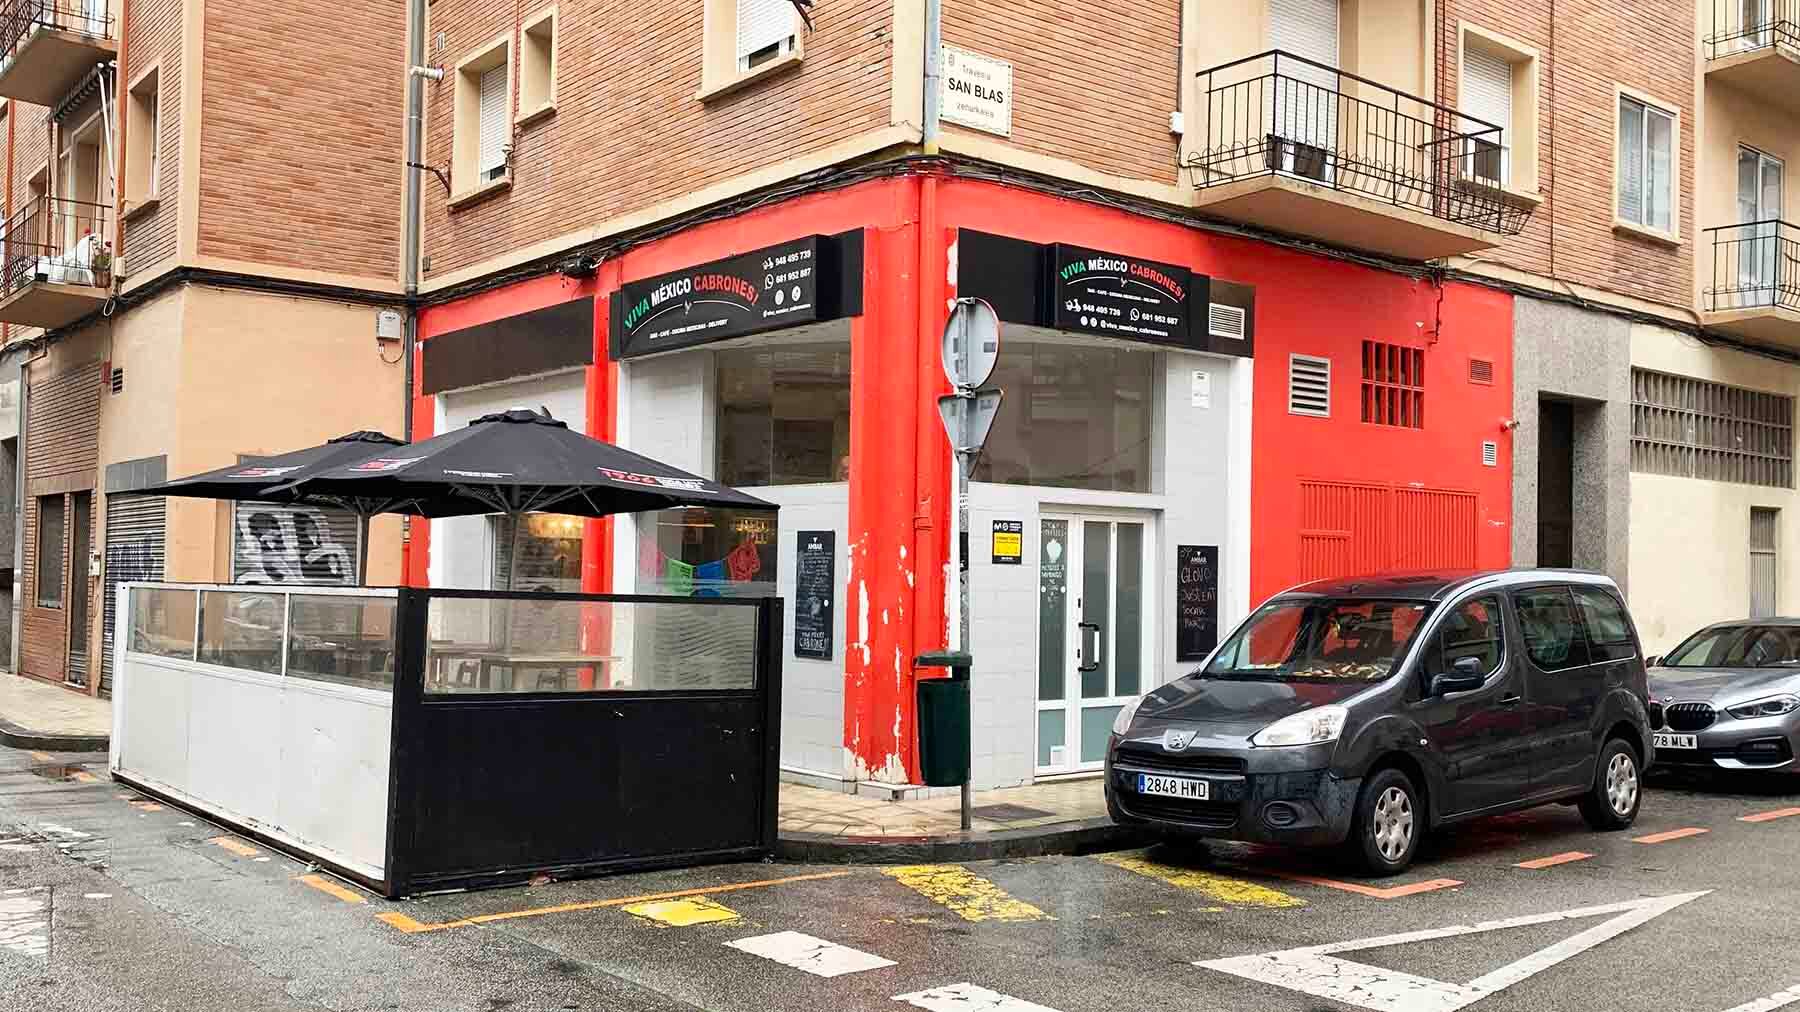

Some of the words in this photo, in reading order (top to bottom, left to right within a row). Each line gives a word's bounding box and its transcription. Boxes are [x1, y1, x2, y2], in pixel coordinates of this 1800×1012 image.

[948, 77, 971, 95] SAN
[974, 85, 1004, 104] BLAS
[1060, 261, 1087, 280] VIVA
[1088, 257, 1128, 273] MÉXICO
[1130, 263, 1187, 301] CABRONES!
[624, 297, 650, 329] VIVA
[651, 277, 692, 308] MÉXICO
[693, 273, 759, 306] CABRONES!
[1653, 735, 1668, 747] 78
[1671, 735, 1694, 747] MLW
[1147, 777, 1177, 794] 2848
[1181, 780, 1206, 798] HWD
